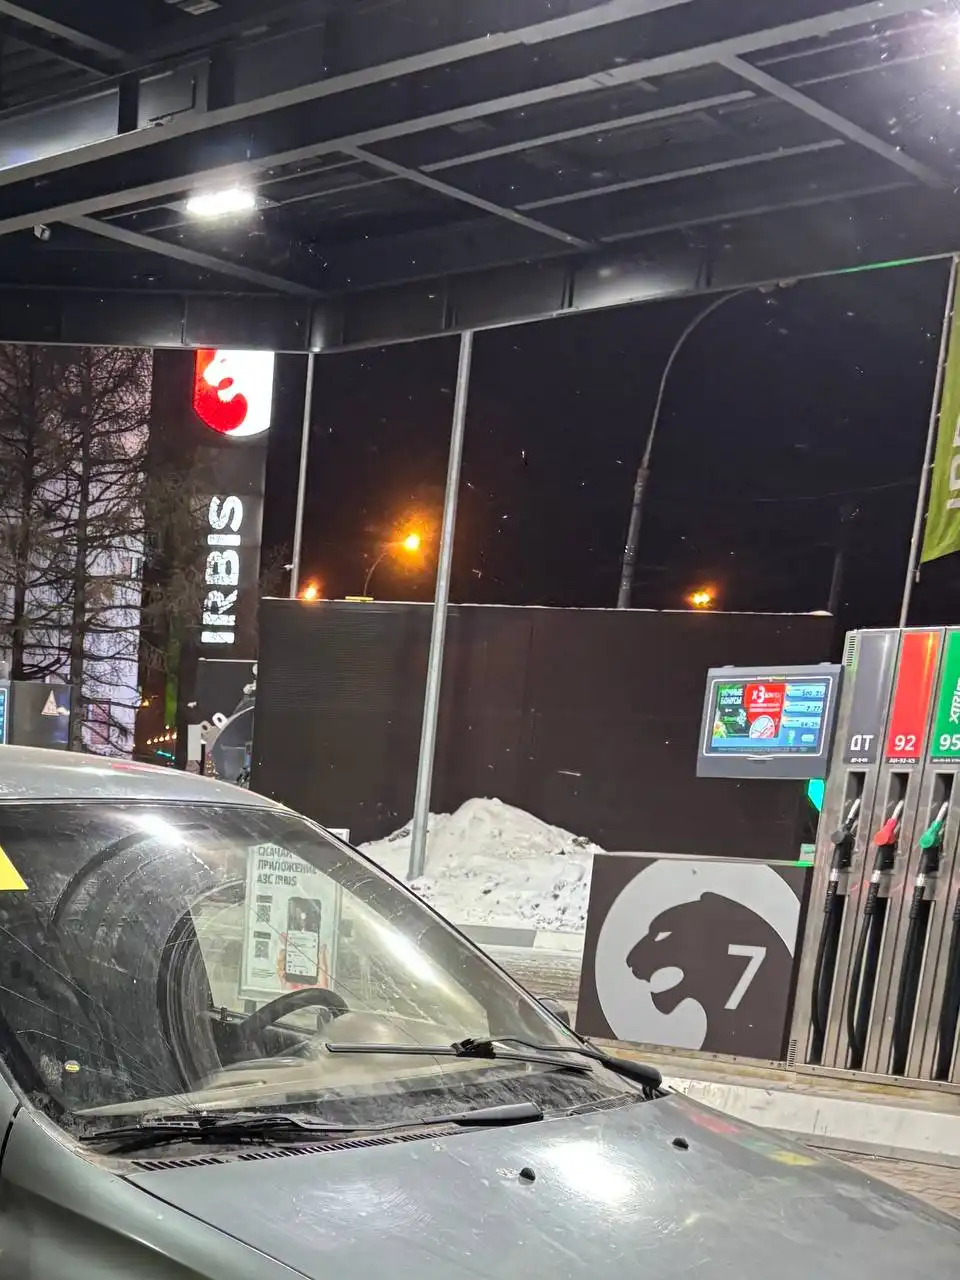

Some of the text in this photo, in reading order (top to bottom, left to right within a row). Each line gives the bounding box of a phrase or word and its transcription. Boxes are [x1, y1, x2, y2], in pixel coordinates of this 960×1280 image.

[201, 495, 243, 643] IRBIS
[850, 734, 874, 751] ДТ
[894, 734, 917, 751] 92
[939, 734, 960, 751] 95
[724, 943, 767, 1010] 7
